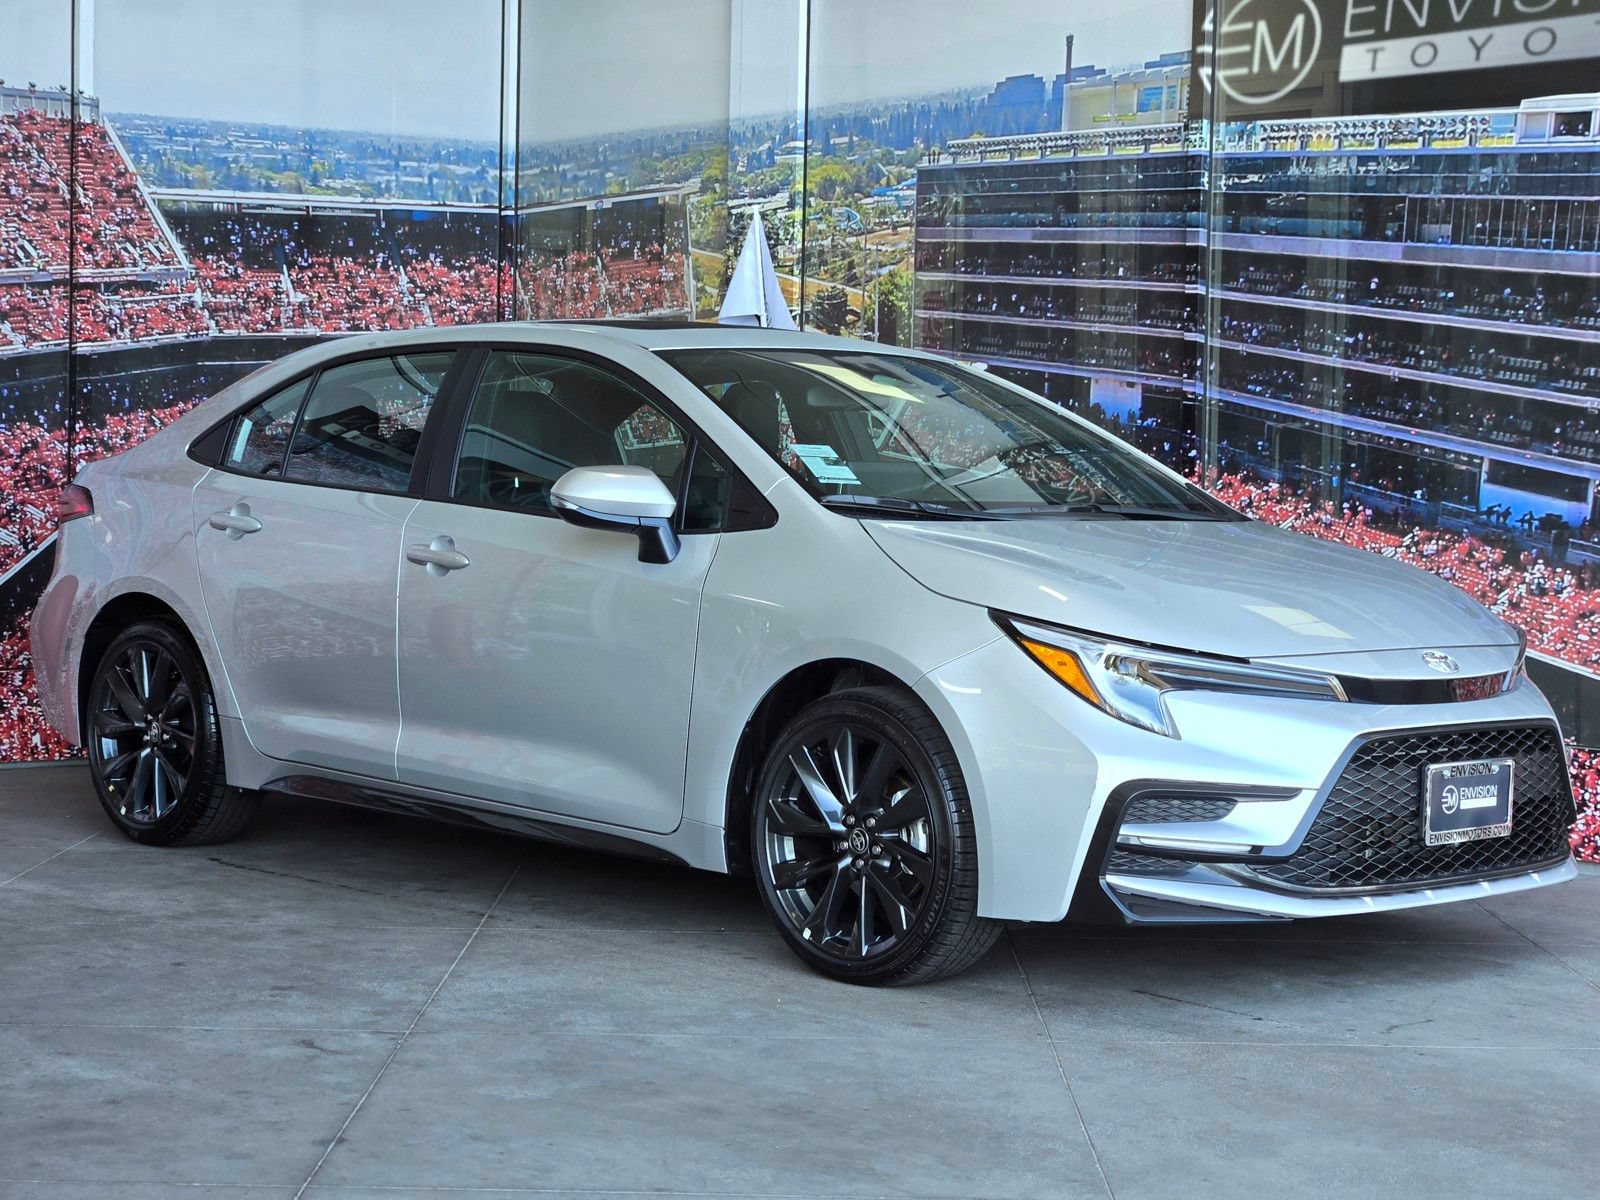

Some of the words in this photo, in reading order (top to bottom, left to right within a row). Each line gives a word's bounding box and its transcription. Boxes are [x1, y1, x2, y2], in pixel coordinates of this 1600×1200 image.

[1366, 20, 1600, 72] TOYO
[1450, 763, 1492, 777] ENVISION
[1460, 785, 1497, 799] ENVISION
[1430, 824, 1511, 844] ENVISIONMOTORS.COM
